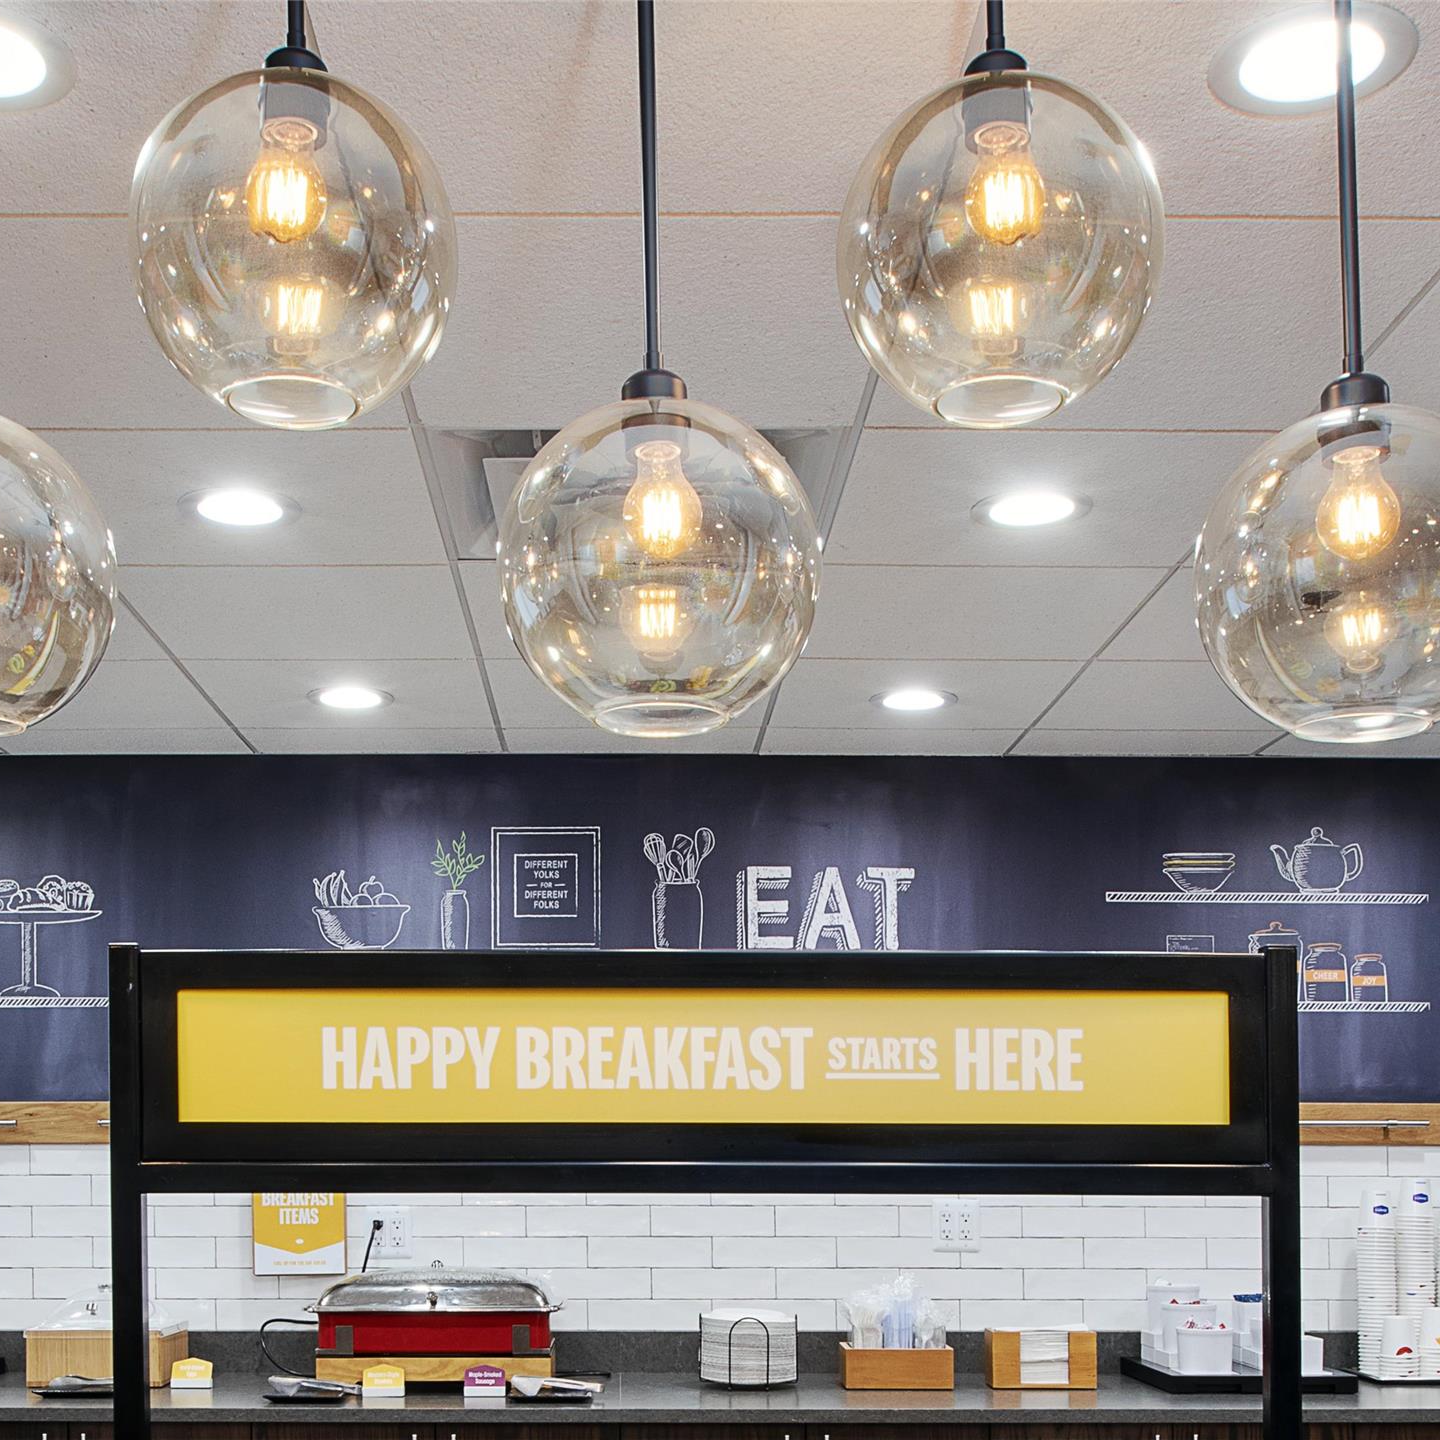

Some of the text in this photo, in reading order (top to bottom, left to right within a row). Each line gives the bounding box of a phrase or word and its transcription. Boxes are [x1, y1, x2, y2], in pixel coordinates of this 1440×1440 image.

[525, 860, 568, 869] DIFFERENT
[533, 871, 560, 879] YOLKS
[525, 890, 568, 899] DIFFERENT
[533, 901, 560, 909] FOLKS
[738, 866, 916, 950] EAT
[321, 1026, 1084, 1092] HAPPY BREAKFAST STARTS HERE
[262, 1193, 334, 1206] BREAKFAST
[279, 1208, 319, 1224] ITEMS
